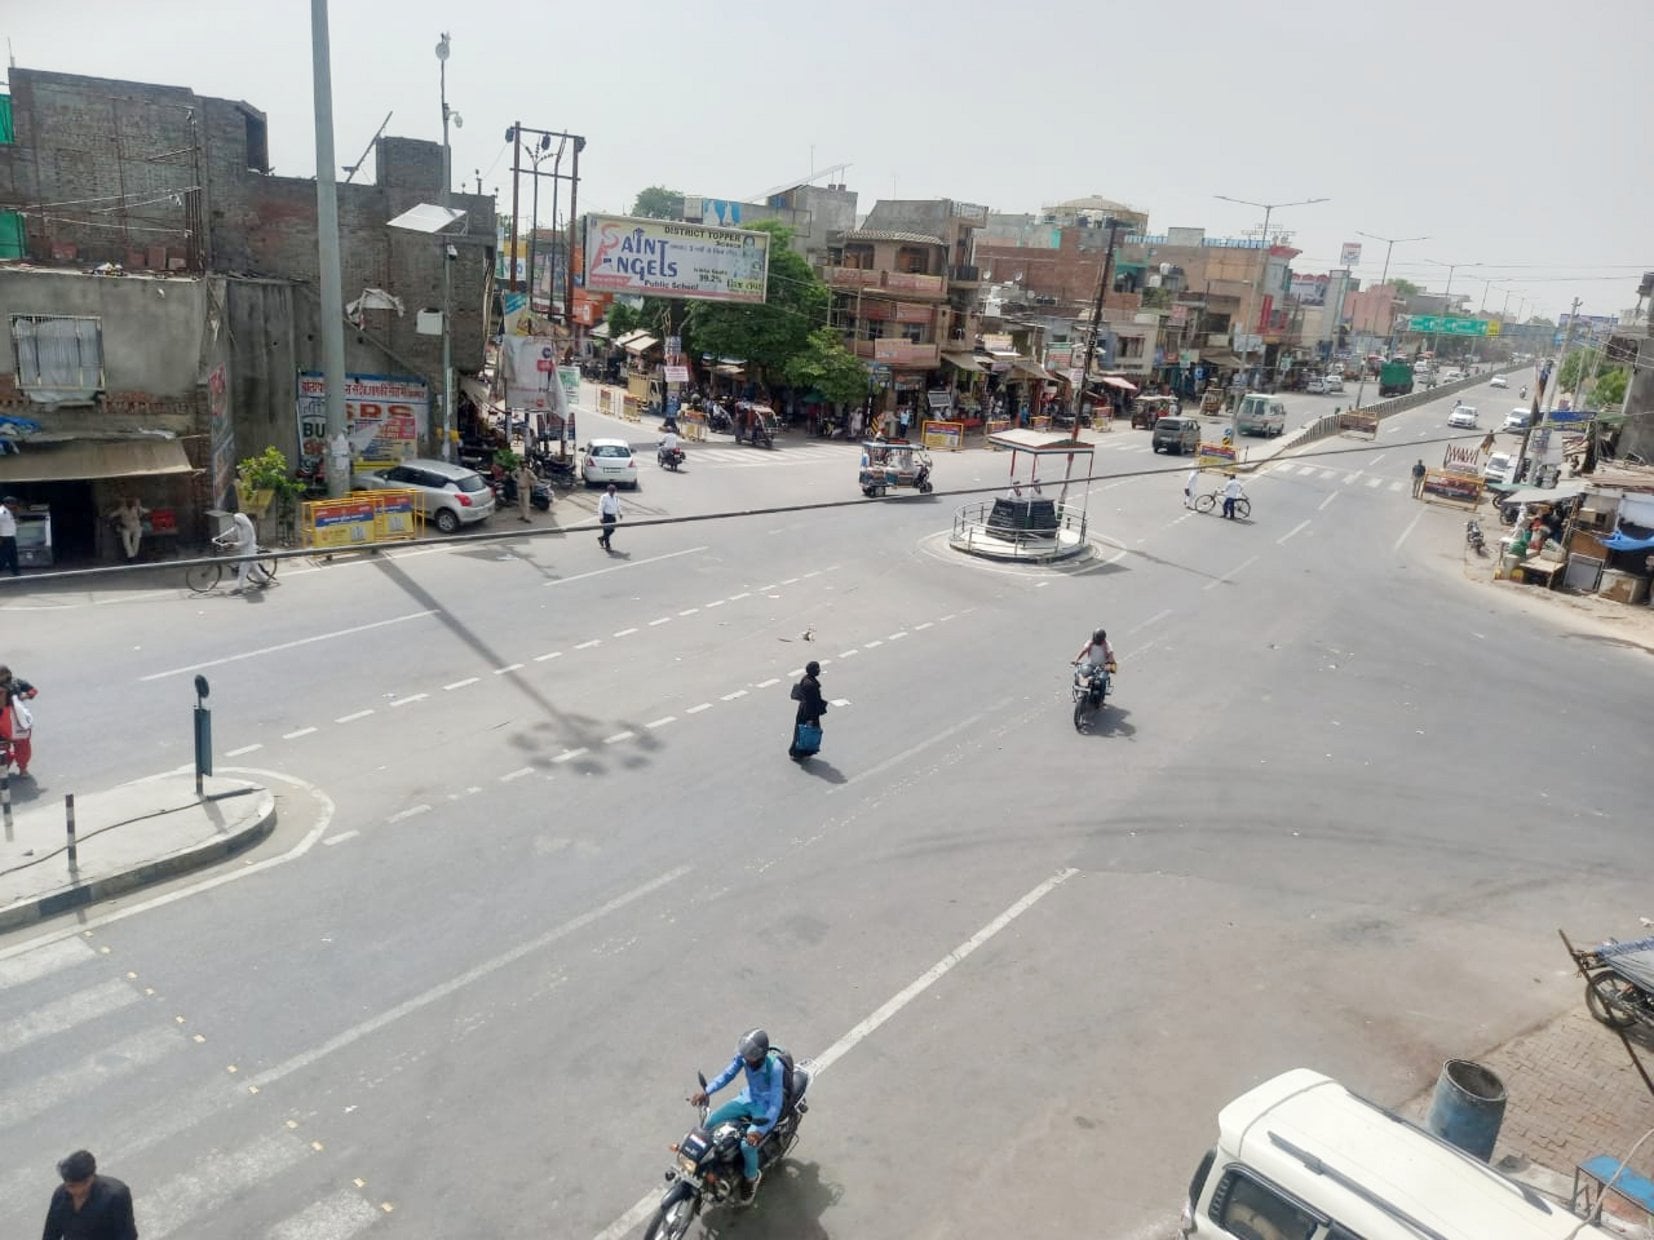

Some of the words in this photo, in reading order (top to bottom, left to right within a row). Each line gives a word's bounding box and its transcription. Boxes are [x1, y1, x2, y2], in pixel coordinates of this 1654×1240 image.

[664, 226, 704, 238] DISTRICT
[708, 231, 741, 242] TOPPER
[671, 282, 699, 290] School
